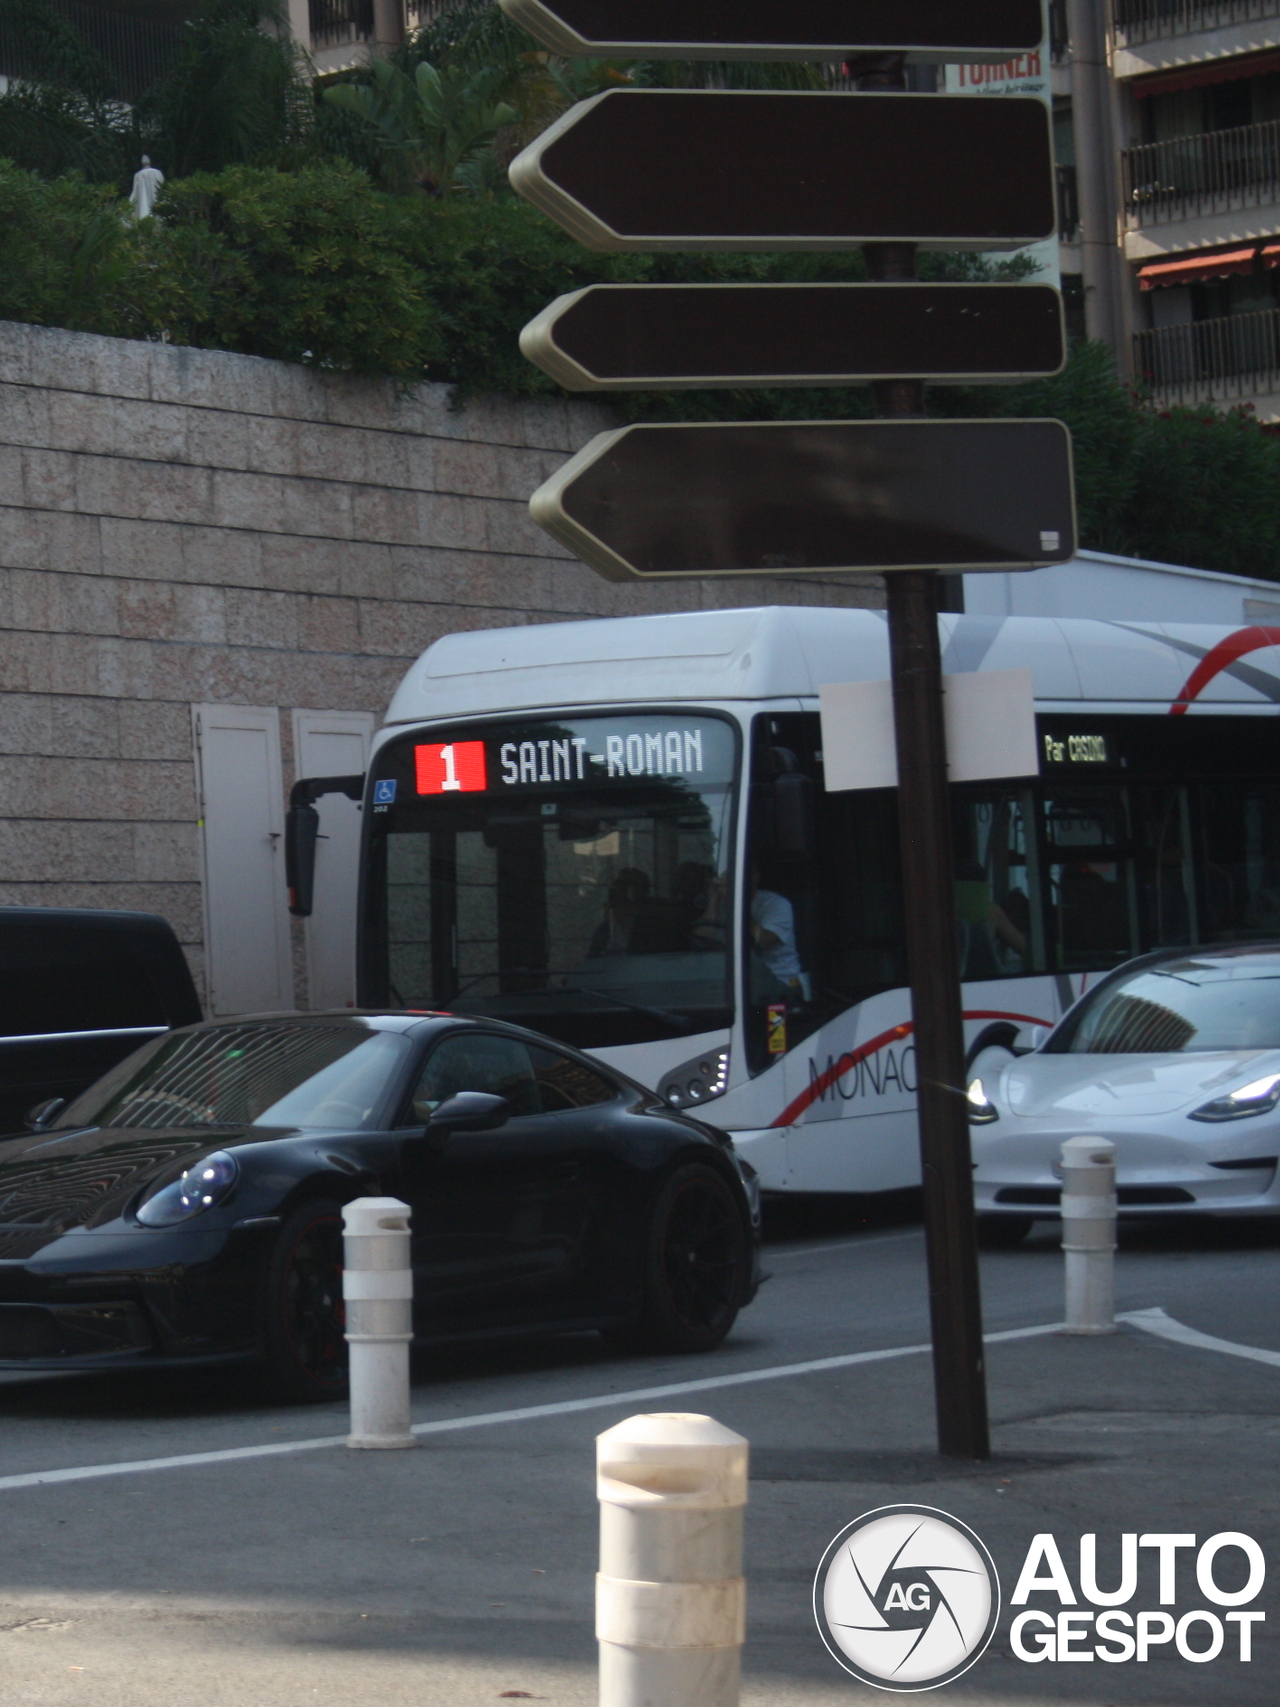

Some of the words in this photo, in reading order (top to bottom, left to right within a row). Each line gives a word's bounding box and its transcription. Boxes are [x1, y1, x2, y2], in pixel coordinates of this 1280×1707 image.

[440, 744, 461, 792] 1
[500, 729, 704, 784] SAINT-ROMAN
[809, 1045, 918, 1102] MONAC
